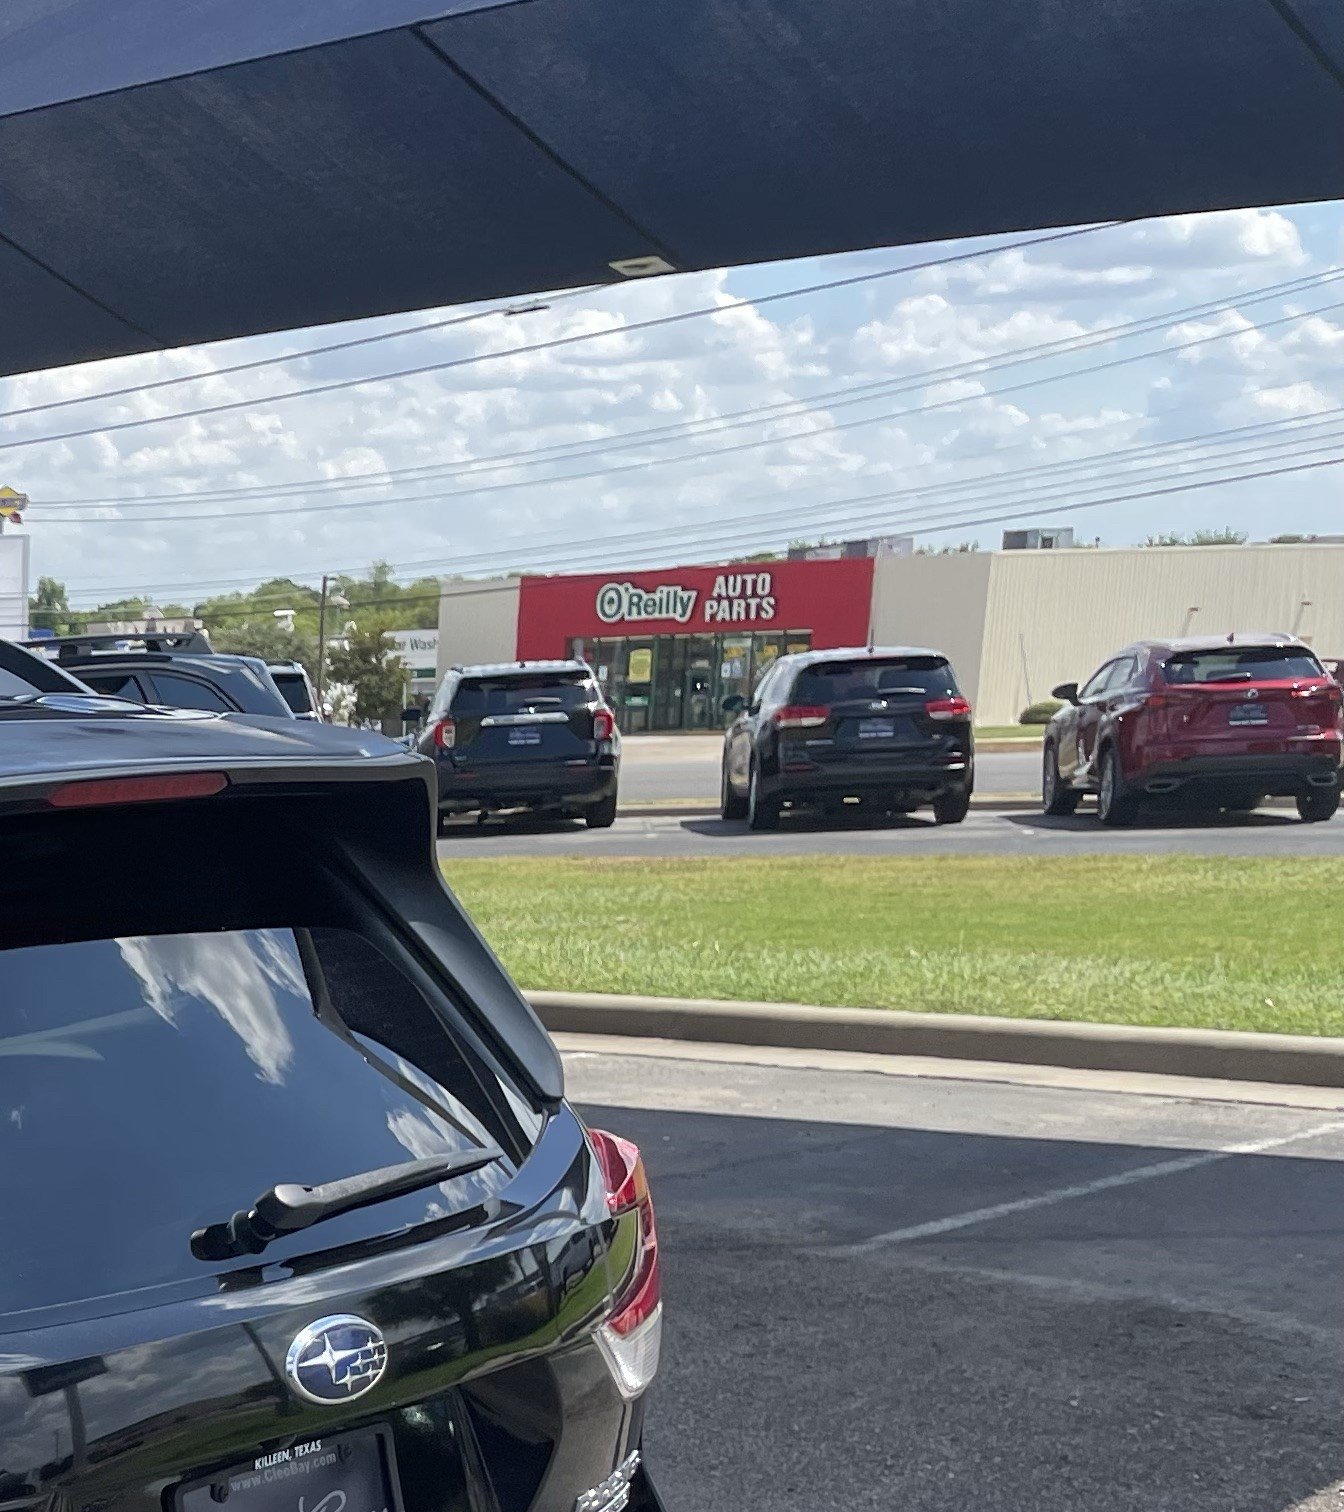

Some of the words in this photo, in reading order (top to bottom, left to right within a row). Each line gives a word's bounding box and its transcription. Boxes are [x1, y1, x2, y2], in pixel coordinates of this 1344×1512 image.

[712, 573, 771, 597] AUTO
[597, 583, 696, 622] O'Reilly
[705, 597, 775, 623] PARTS
[254, 1448, 292, 1471] KILLEEN,
[294, 1439, 322, 1458] TEXAS
